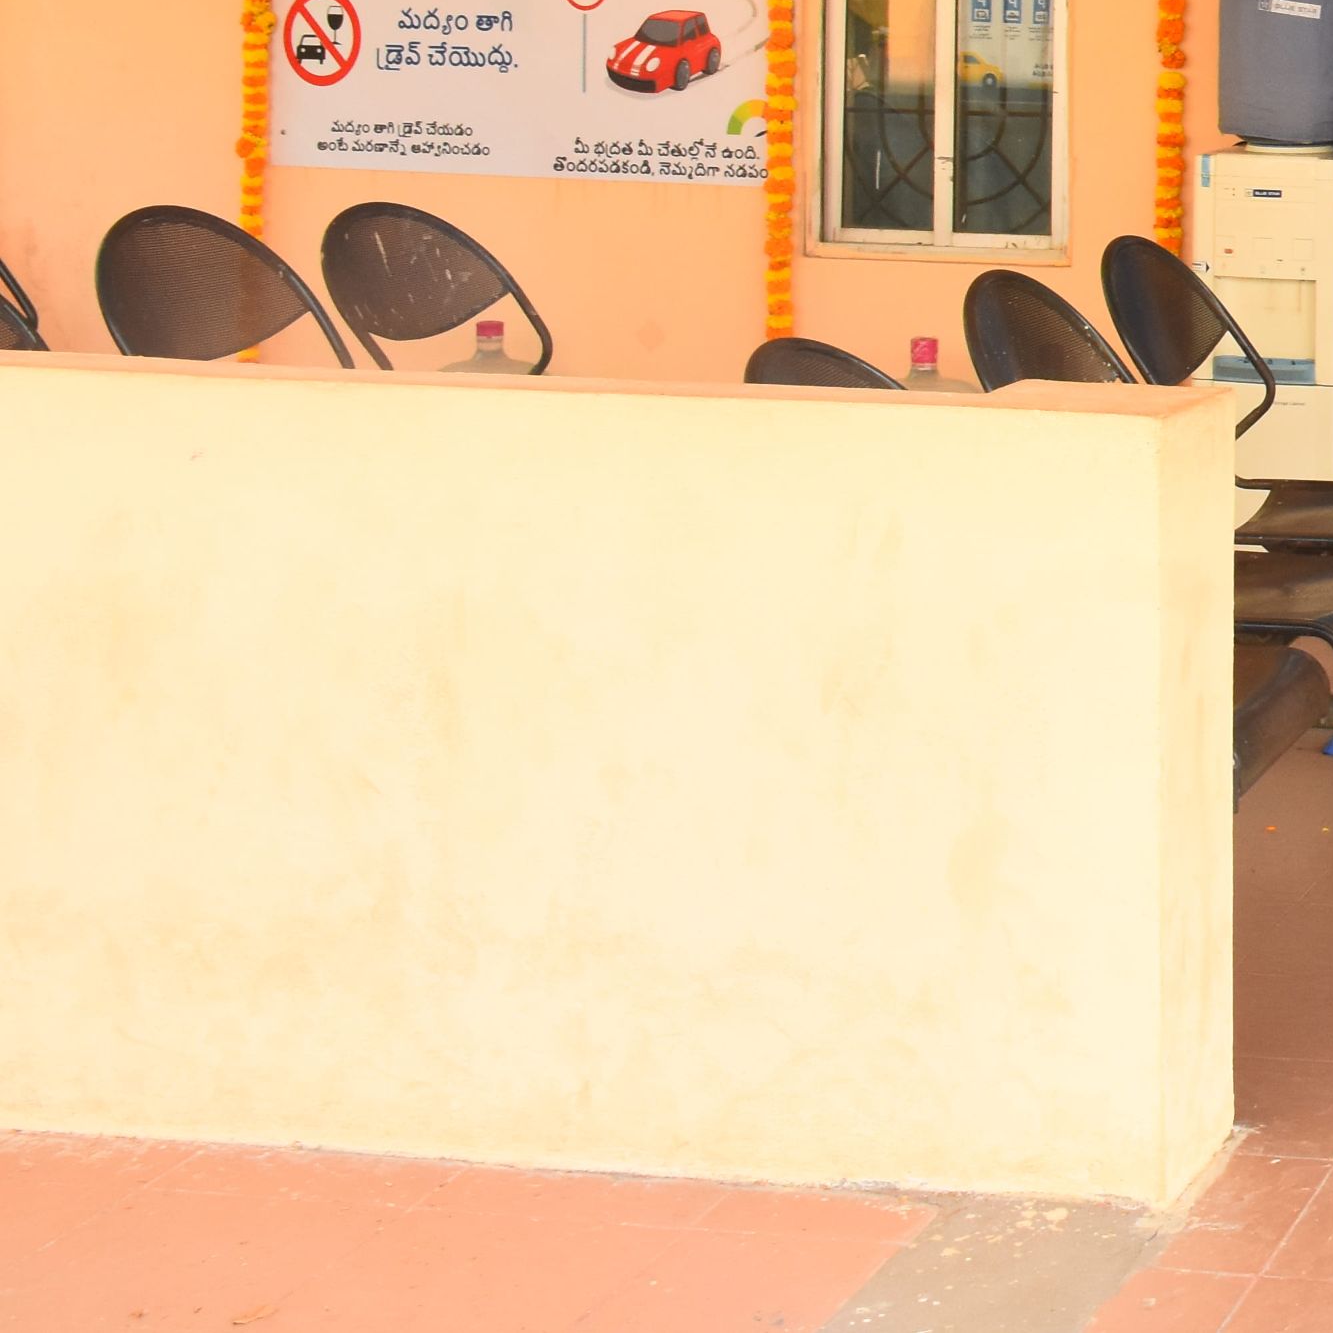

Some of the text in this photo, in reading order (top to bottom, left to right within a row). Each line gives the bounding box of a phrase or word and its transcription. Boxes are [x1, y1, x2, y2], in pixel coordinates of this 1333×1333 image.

[398, 7, 513, 35] మద్యం తాగి
[376, 41, 518, 73] డ్రైవ్ చేయొద్దు.
[331, 120, 473, 138] మద్యం తాగి డ్రైవ్ చేయడం
[317, 137, 348, 152] అంటే
[411, 141, 490, 157] ఆహ్వానించడం
[574, 137, 760, 161] మీ భద్రత మీ చేతుల్లోనే ఉంది.
[659, 161, 720, 180] నెమ్మదిగా
[724, 163, 768, 179] నడపం
